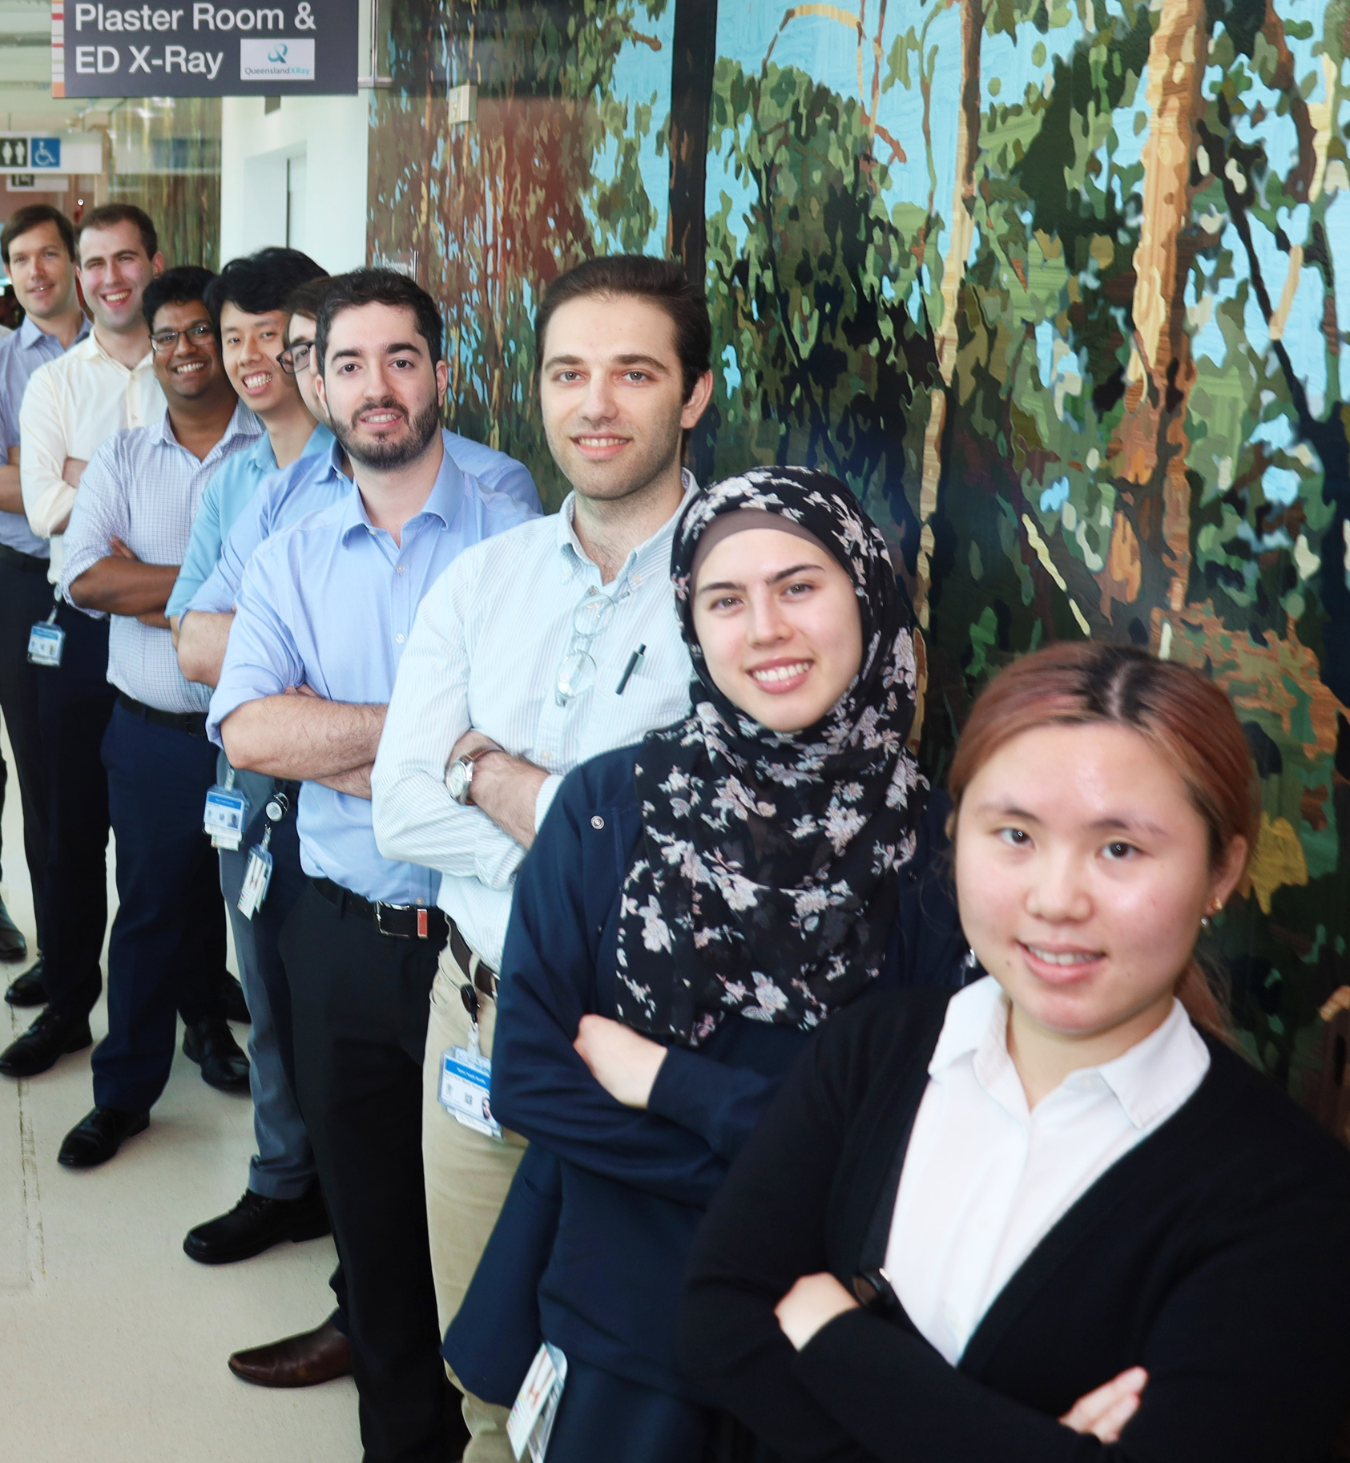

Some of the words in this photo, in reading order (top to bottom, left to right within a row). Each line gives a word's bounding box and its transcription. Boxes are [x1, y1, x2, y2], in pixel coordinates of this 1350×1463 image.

[75, 3, 184, 31] Plaster
[193, 3, 285, 31] Room
[294, 2, 317, 30] &
[75, 45, 120, 74] ED
[128, 45, 224, 80] X-Ray
